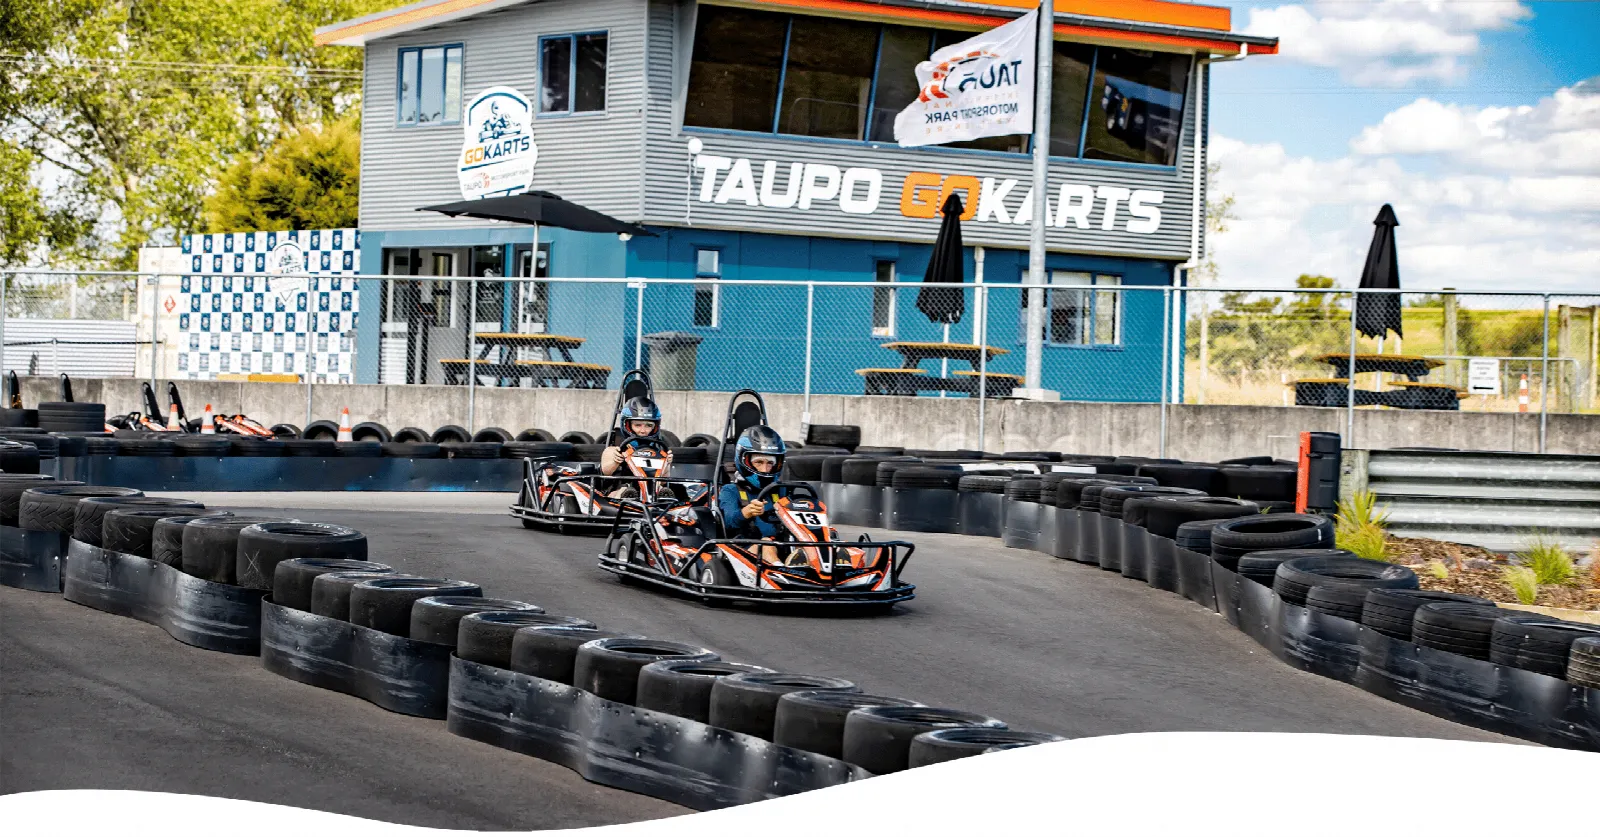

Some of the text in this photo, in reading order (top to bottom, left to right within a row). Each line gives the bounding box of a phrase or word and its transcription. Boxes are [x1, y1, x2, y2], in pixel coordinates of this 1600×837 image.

[464, 135, 530, 165] GOKARTS
[696, 154, 882, 214] TAUPO
[642, 459, 652, 467] 1
[795, 512, 821, 525] 13
